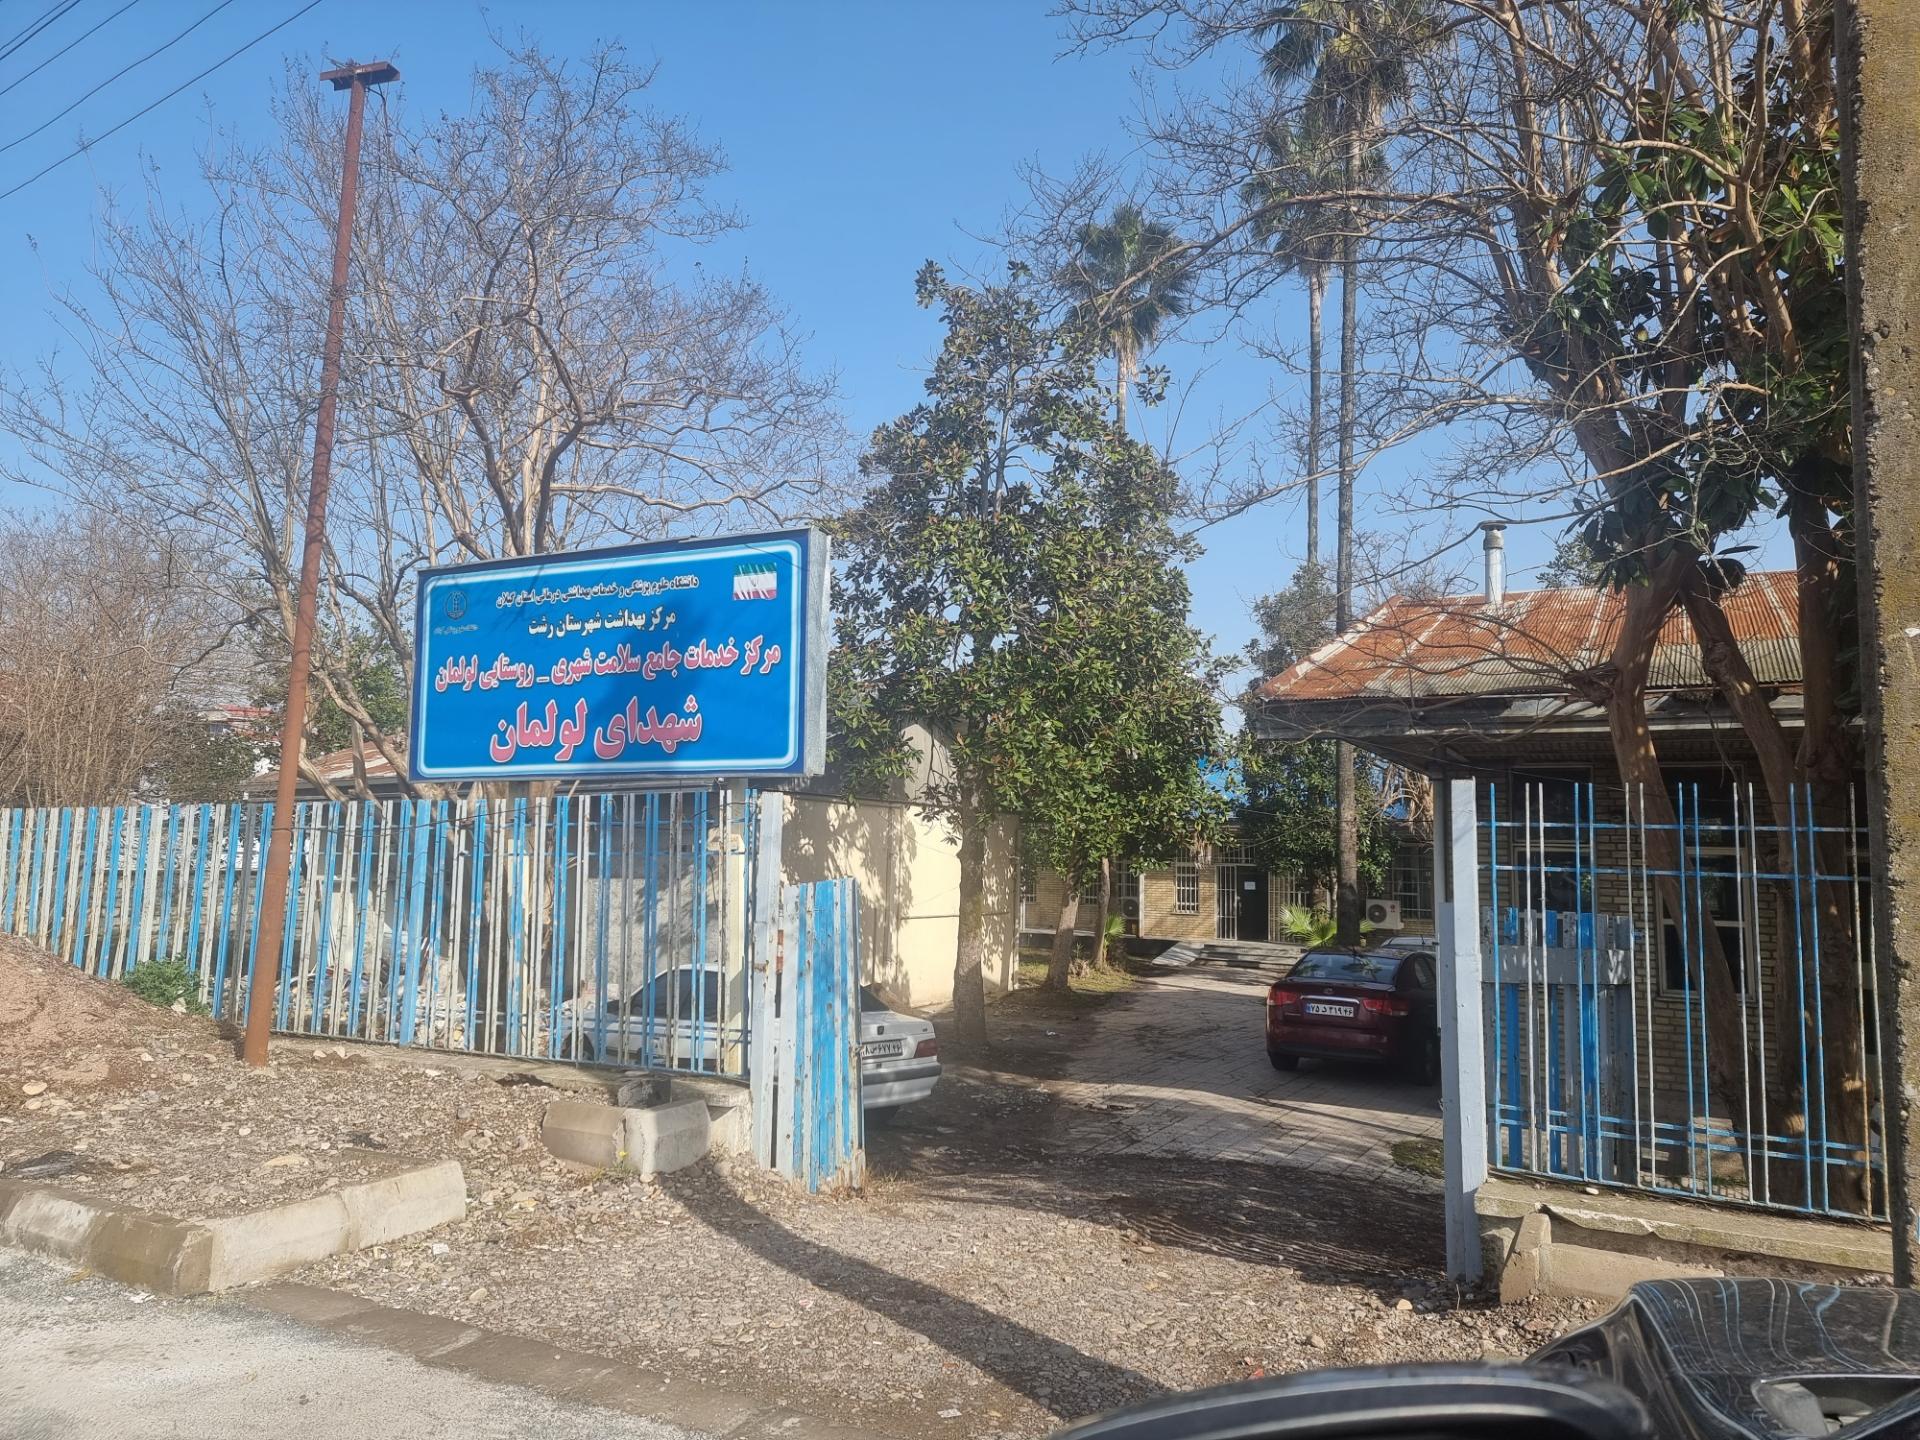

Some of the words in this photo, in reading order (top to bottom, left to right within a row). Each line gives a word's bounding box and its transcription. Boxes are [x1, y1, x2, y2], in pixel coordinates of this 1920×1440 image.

[561, 585, 591, 603] بهداشتی
[592, 582, 618, 597] خدمات
[624, 579, 651, 598] پزشکی
[651, 577, 670, 595] علوم
[669, 573, 699, 590] دانشگاه
[496, 591, 516, 609] گیلان
[515, 588, 535, 607] استان
[535, 587, 561, 605] درمانی
[528, 615, 554, 639] رشت
[556, 611, 602, 638] شهرستان
[604, 609, 646, 631] بهداشت
[649, 606, 676, 631] مرکز
[551, 647, 593, 685] شهری
[594, 643, 641, 675] سلامت
[642, 641, 682, 680] جامع
[684, 637, 739, 670] خدمات
[740, 635, 781, 675] مرکز
[435, 654, 478, 692] لولمان
[479, 652, 535, 690] روستایی
[489, 697, 588, 763] لولمان
[594, 694, 703, 760] شهدای
